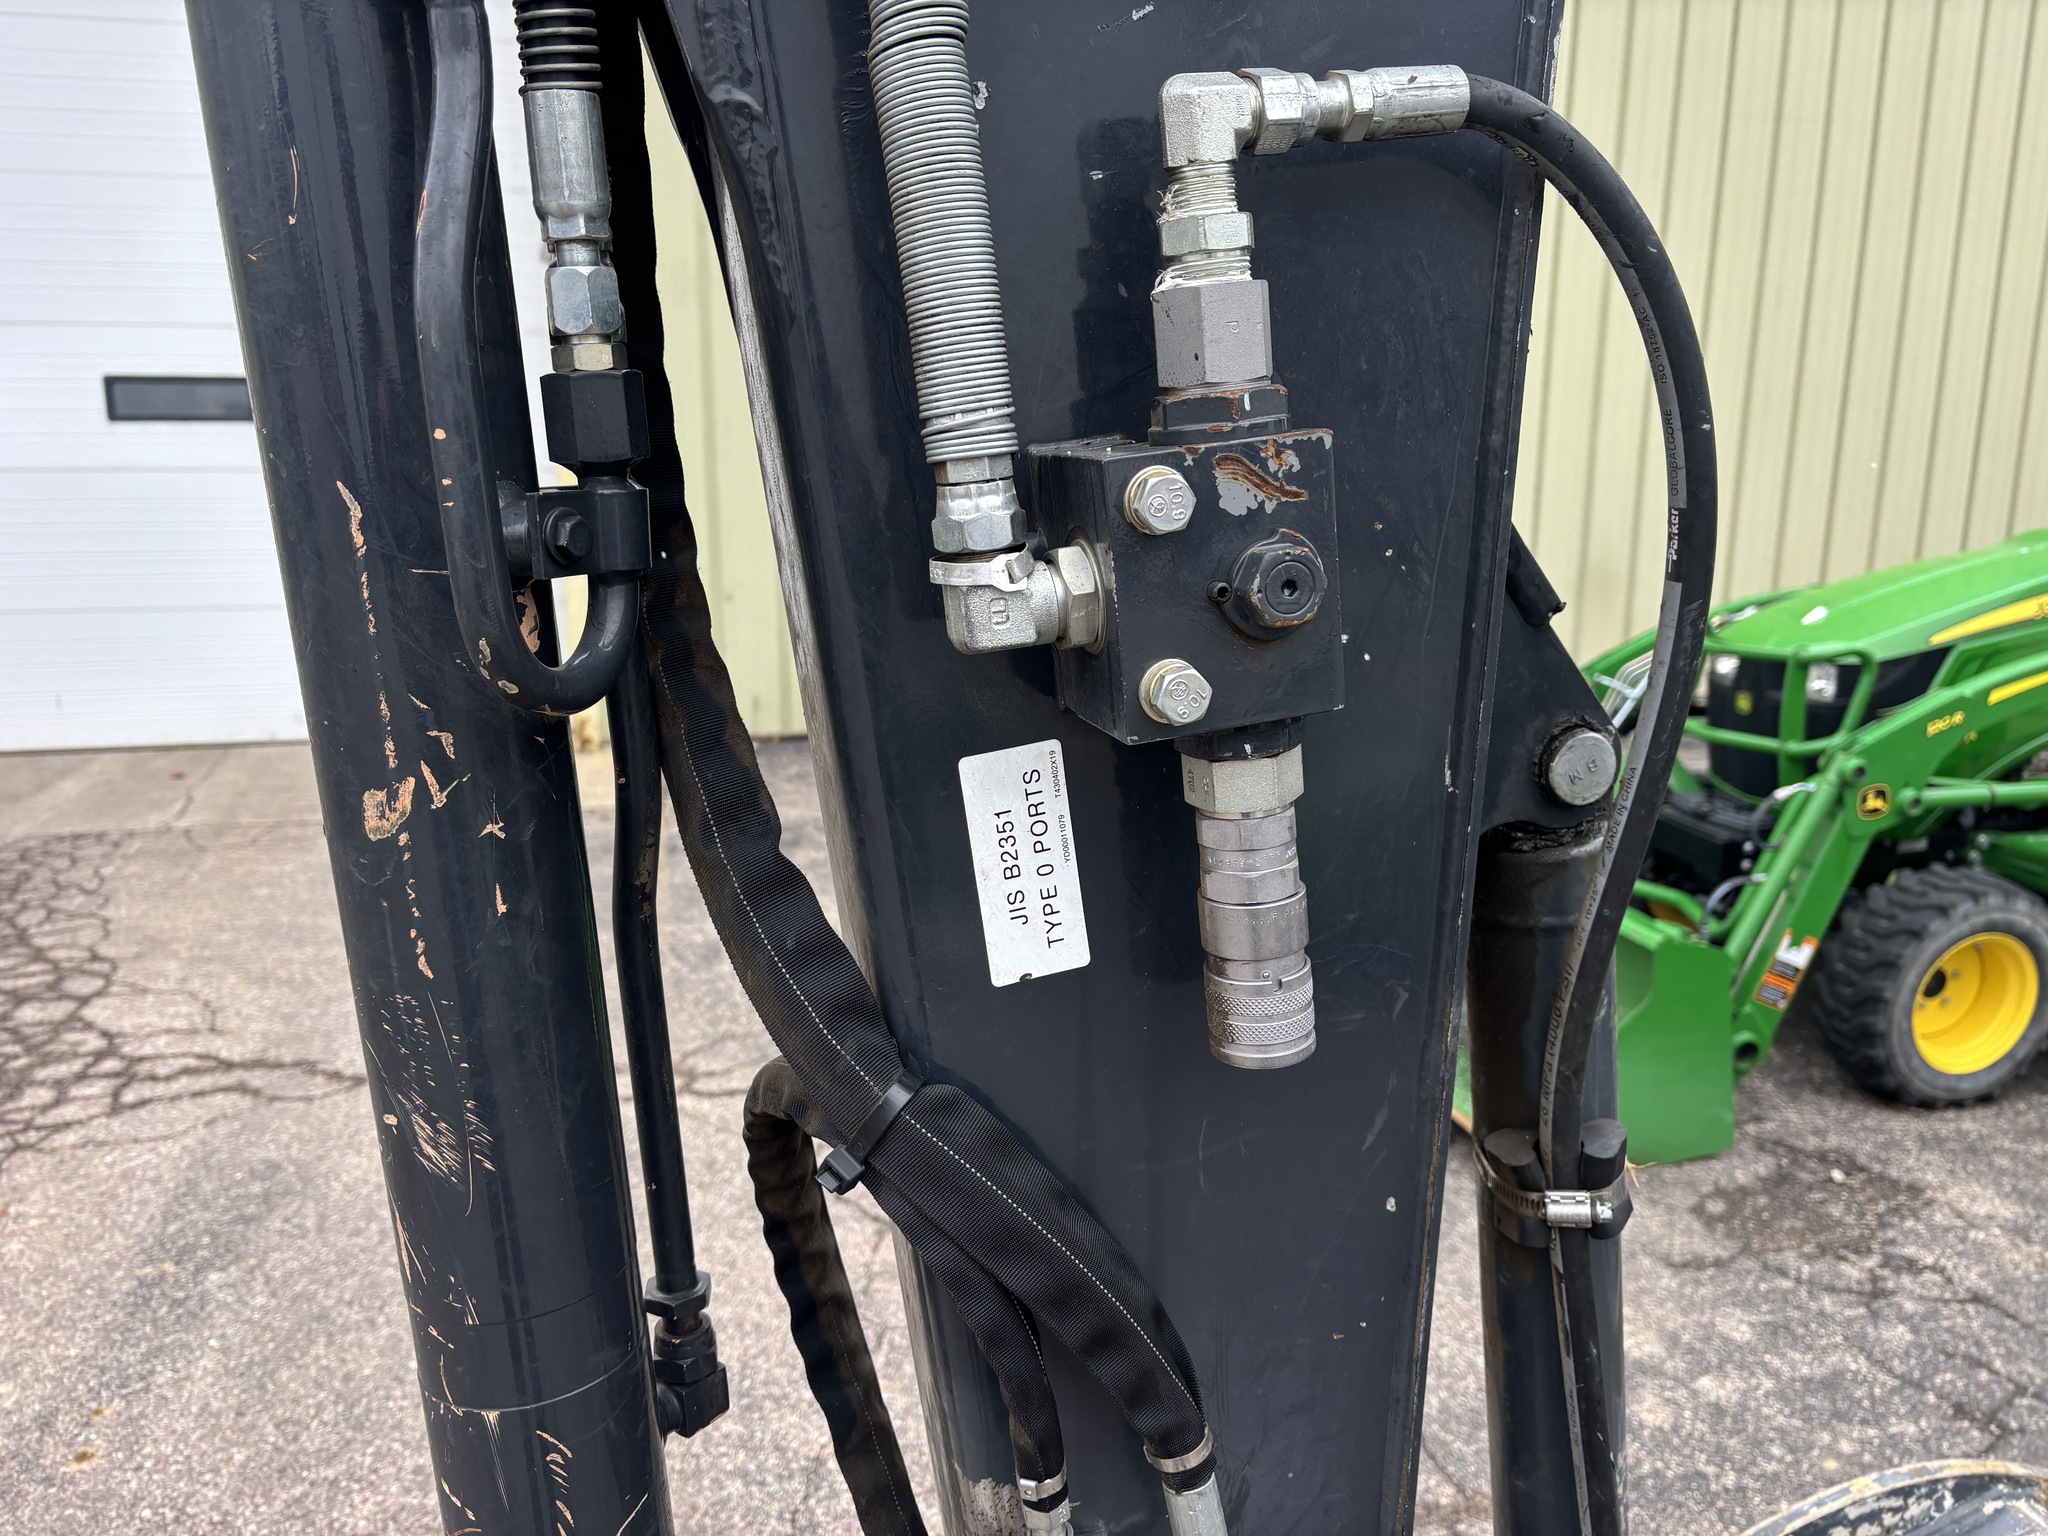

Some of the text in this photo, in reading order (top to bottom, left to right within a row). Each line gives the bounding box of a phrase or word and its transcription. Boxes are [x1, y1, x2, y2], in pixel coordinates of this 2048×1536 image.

[1657, 364, 1668, 384] ISO
[1664, 408, 1679, 497] GLOBALCORE
[1668, 508, 1679, 562] Parker
[1176, 687, 1208, 720] 10.9
[1022, 768, 1051, 854] PORTS
[1049, 750, 1071, 864] YD00011079 T430402X19
[1605, 767, 1637, 854] MADE IN CHINA
[994, 809, 1029, 925] JIS B2351
[1040, 884, 1065, 949] TYPE
